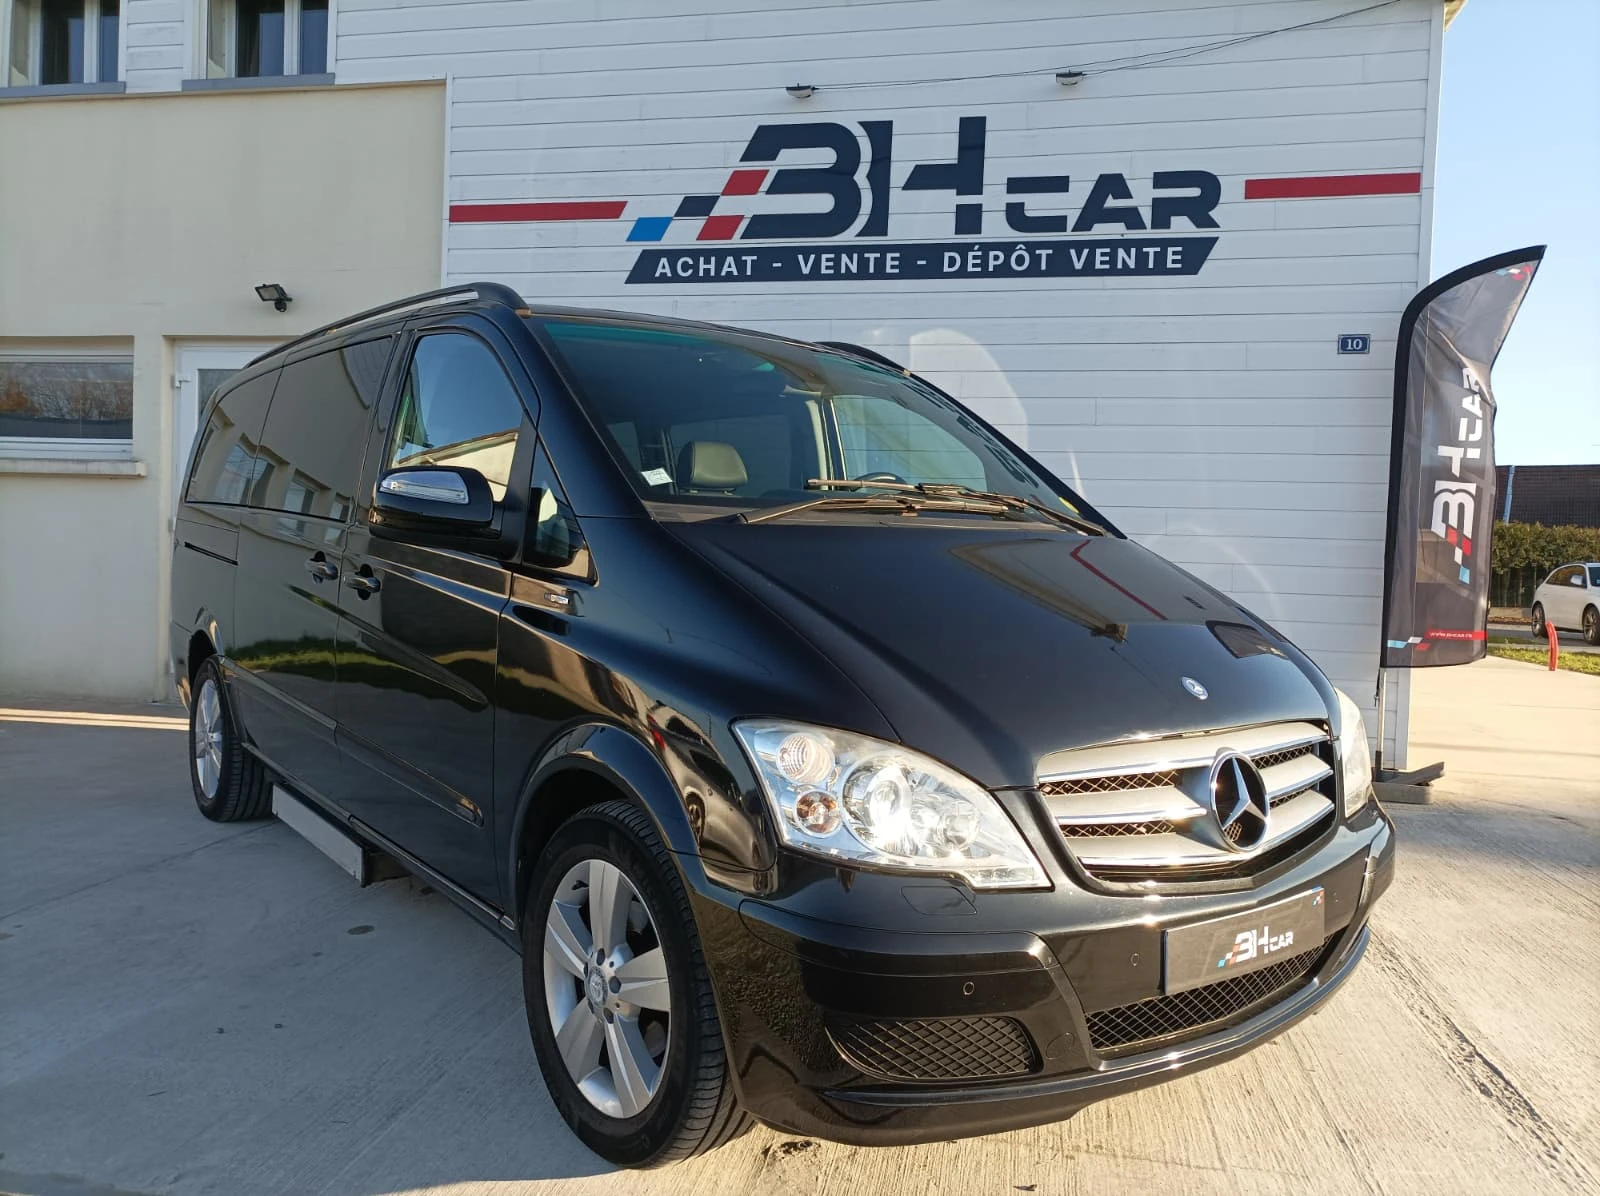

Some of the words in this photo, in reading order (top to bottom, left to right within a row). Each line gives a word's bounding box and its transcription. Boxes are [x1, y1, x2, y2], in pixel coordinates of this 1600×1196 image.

[654, 255, 758, 278] ACHAT
[797, 252, 901, 275] VENTE
[943, 244, 1053, 272] DÉPÔT
[1069, 247, 1183, 270] VENTE
[1346, 338, 1363, 350] 10
